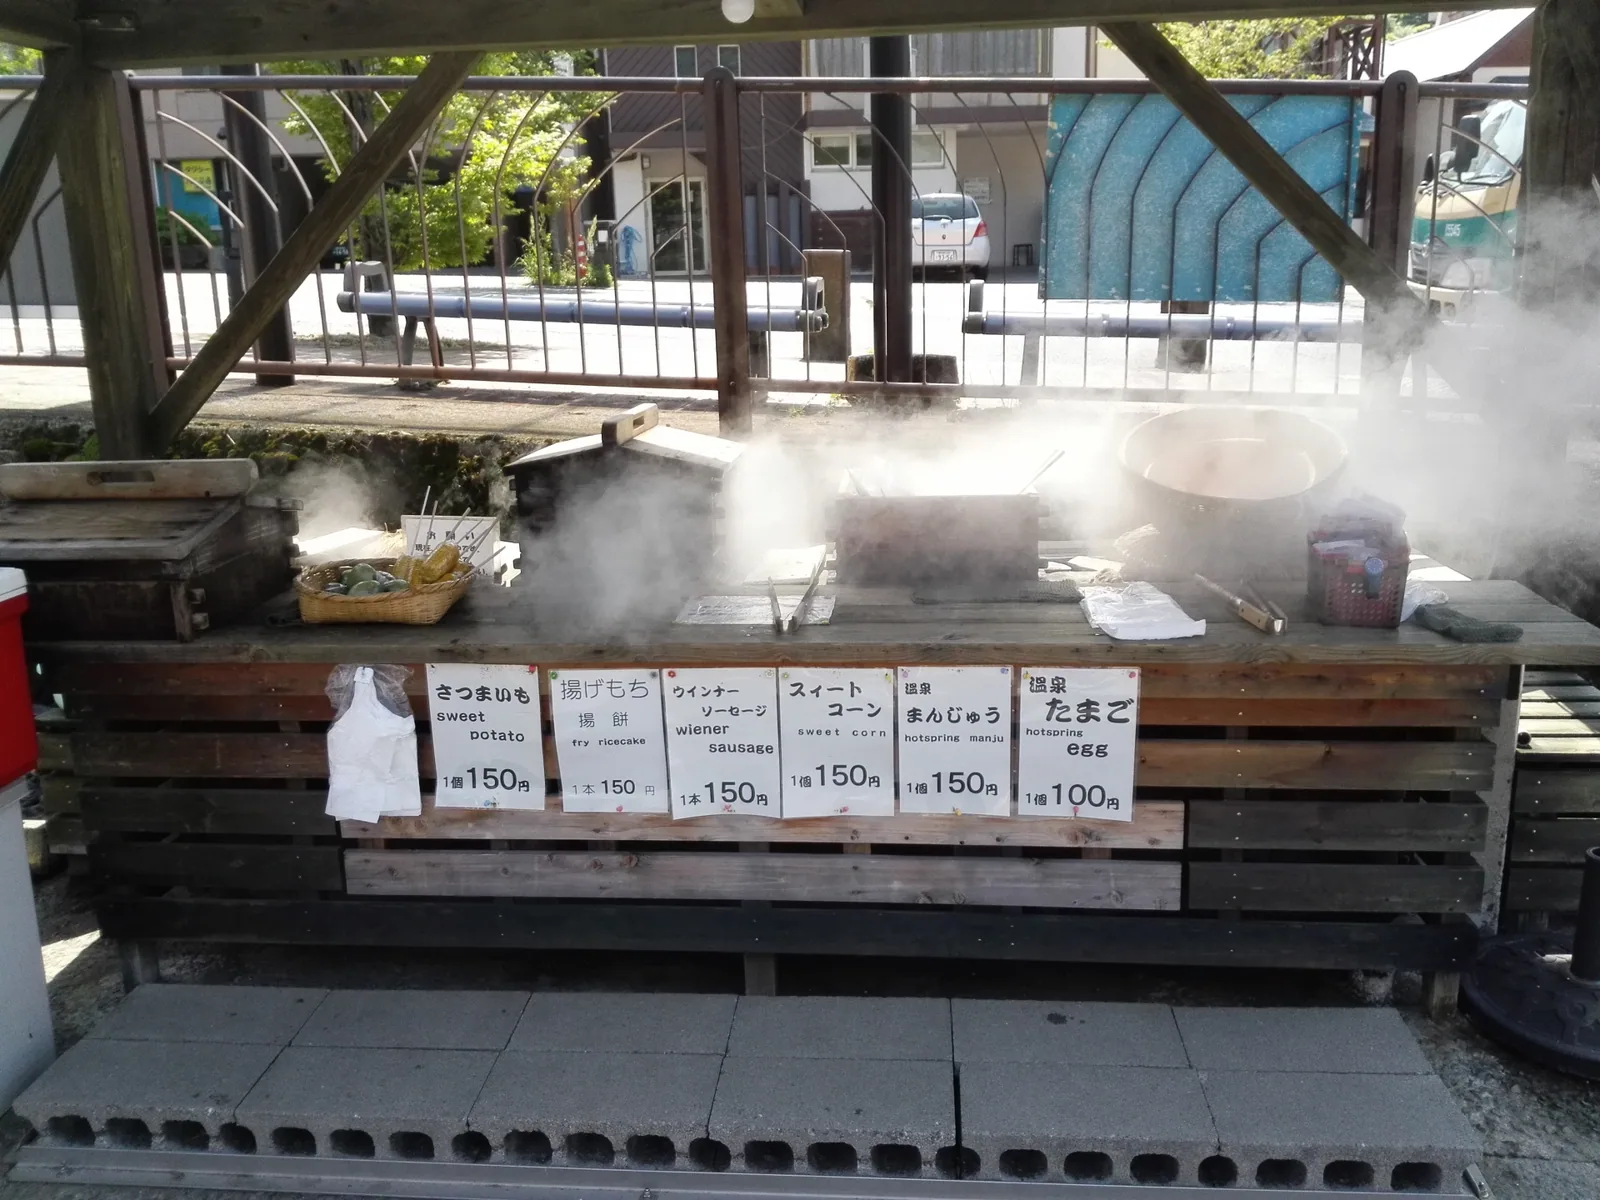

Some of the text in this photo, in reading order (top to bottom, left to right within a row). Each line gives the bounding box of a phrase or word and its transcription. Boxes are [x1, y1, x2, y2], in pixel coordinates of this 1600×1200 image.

[560, 678, 650, 701] 揚げもち
[672, 685, 740, 698] ウインナー
[789, 680, 862, 699] スィート
[904, 682, 932, 696] 温泉
[1029, 676, 1068, 695] 温泉
[435, 683, 531, 705] さつまいも
[436, 711, 486, 723] sweet
[701, 704, 768, 717] ソーセージ
[828, 702, 882, 718] コーン
[906, 706, 1001, 724] まんじゅう
[1046, 697, 1135, 724] たまご
[469, 729, 525, 743] potato
[675, 723, 730, 736] wiener
[797, 727, 886, 738] sweet corn
[1025, 727, 1084, 738] hotspring
[571, 737, 646, 748] fry ricecake
[904, 733, 1004, 744] hotspring manju
[708, 743, 774, 755] sausage
[1066, 742, 1109, 758] egg
